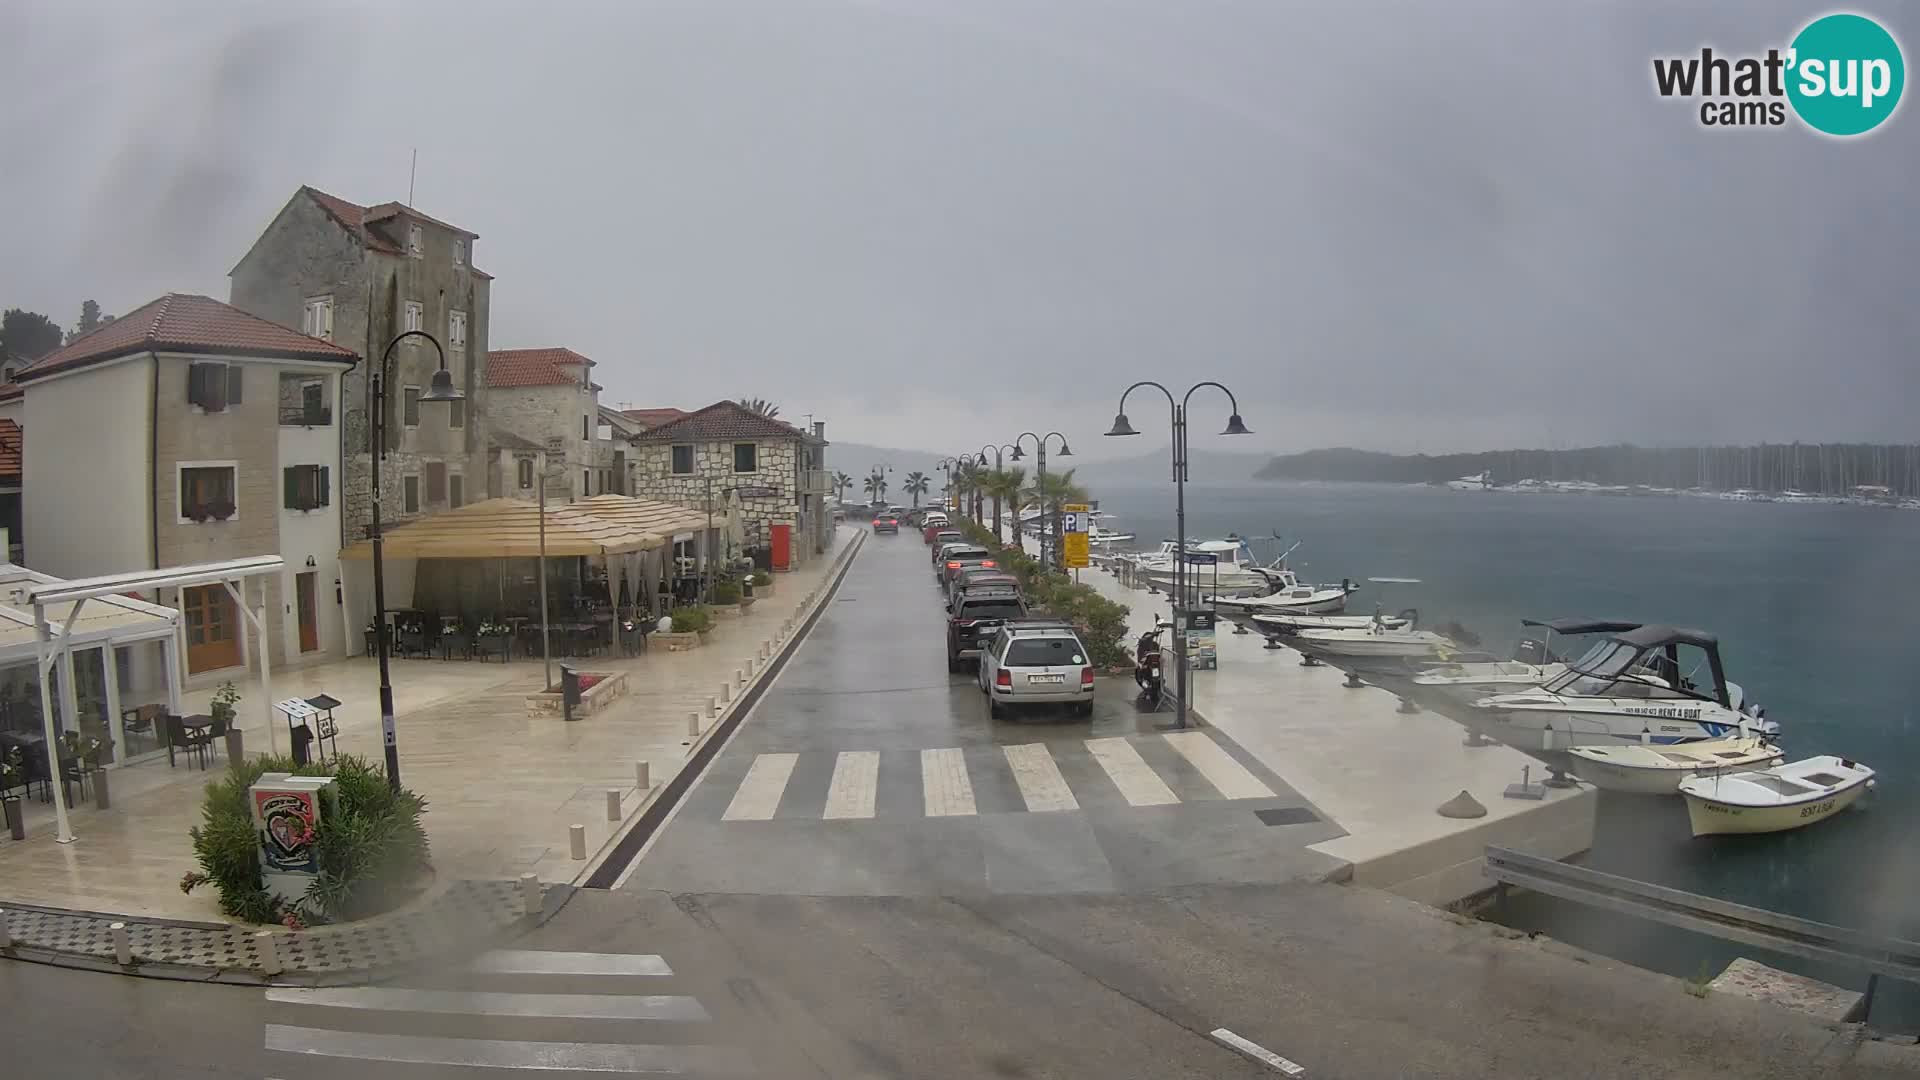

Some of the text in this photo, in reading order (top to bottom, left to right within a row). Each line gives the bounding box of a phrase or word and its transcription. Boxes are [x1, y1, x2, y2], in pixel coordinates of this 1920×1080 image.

[1065, 514, 1076, 530] P
[1658, 707, 1677, 717] RENT
[1683, 708, 1702, 720] BOAT
